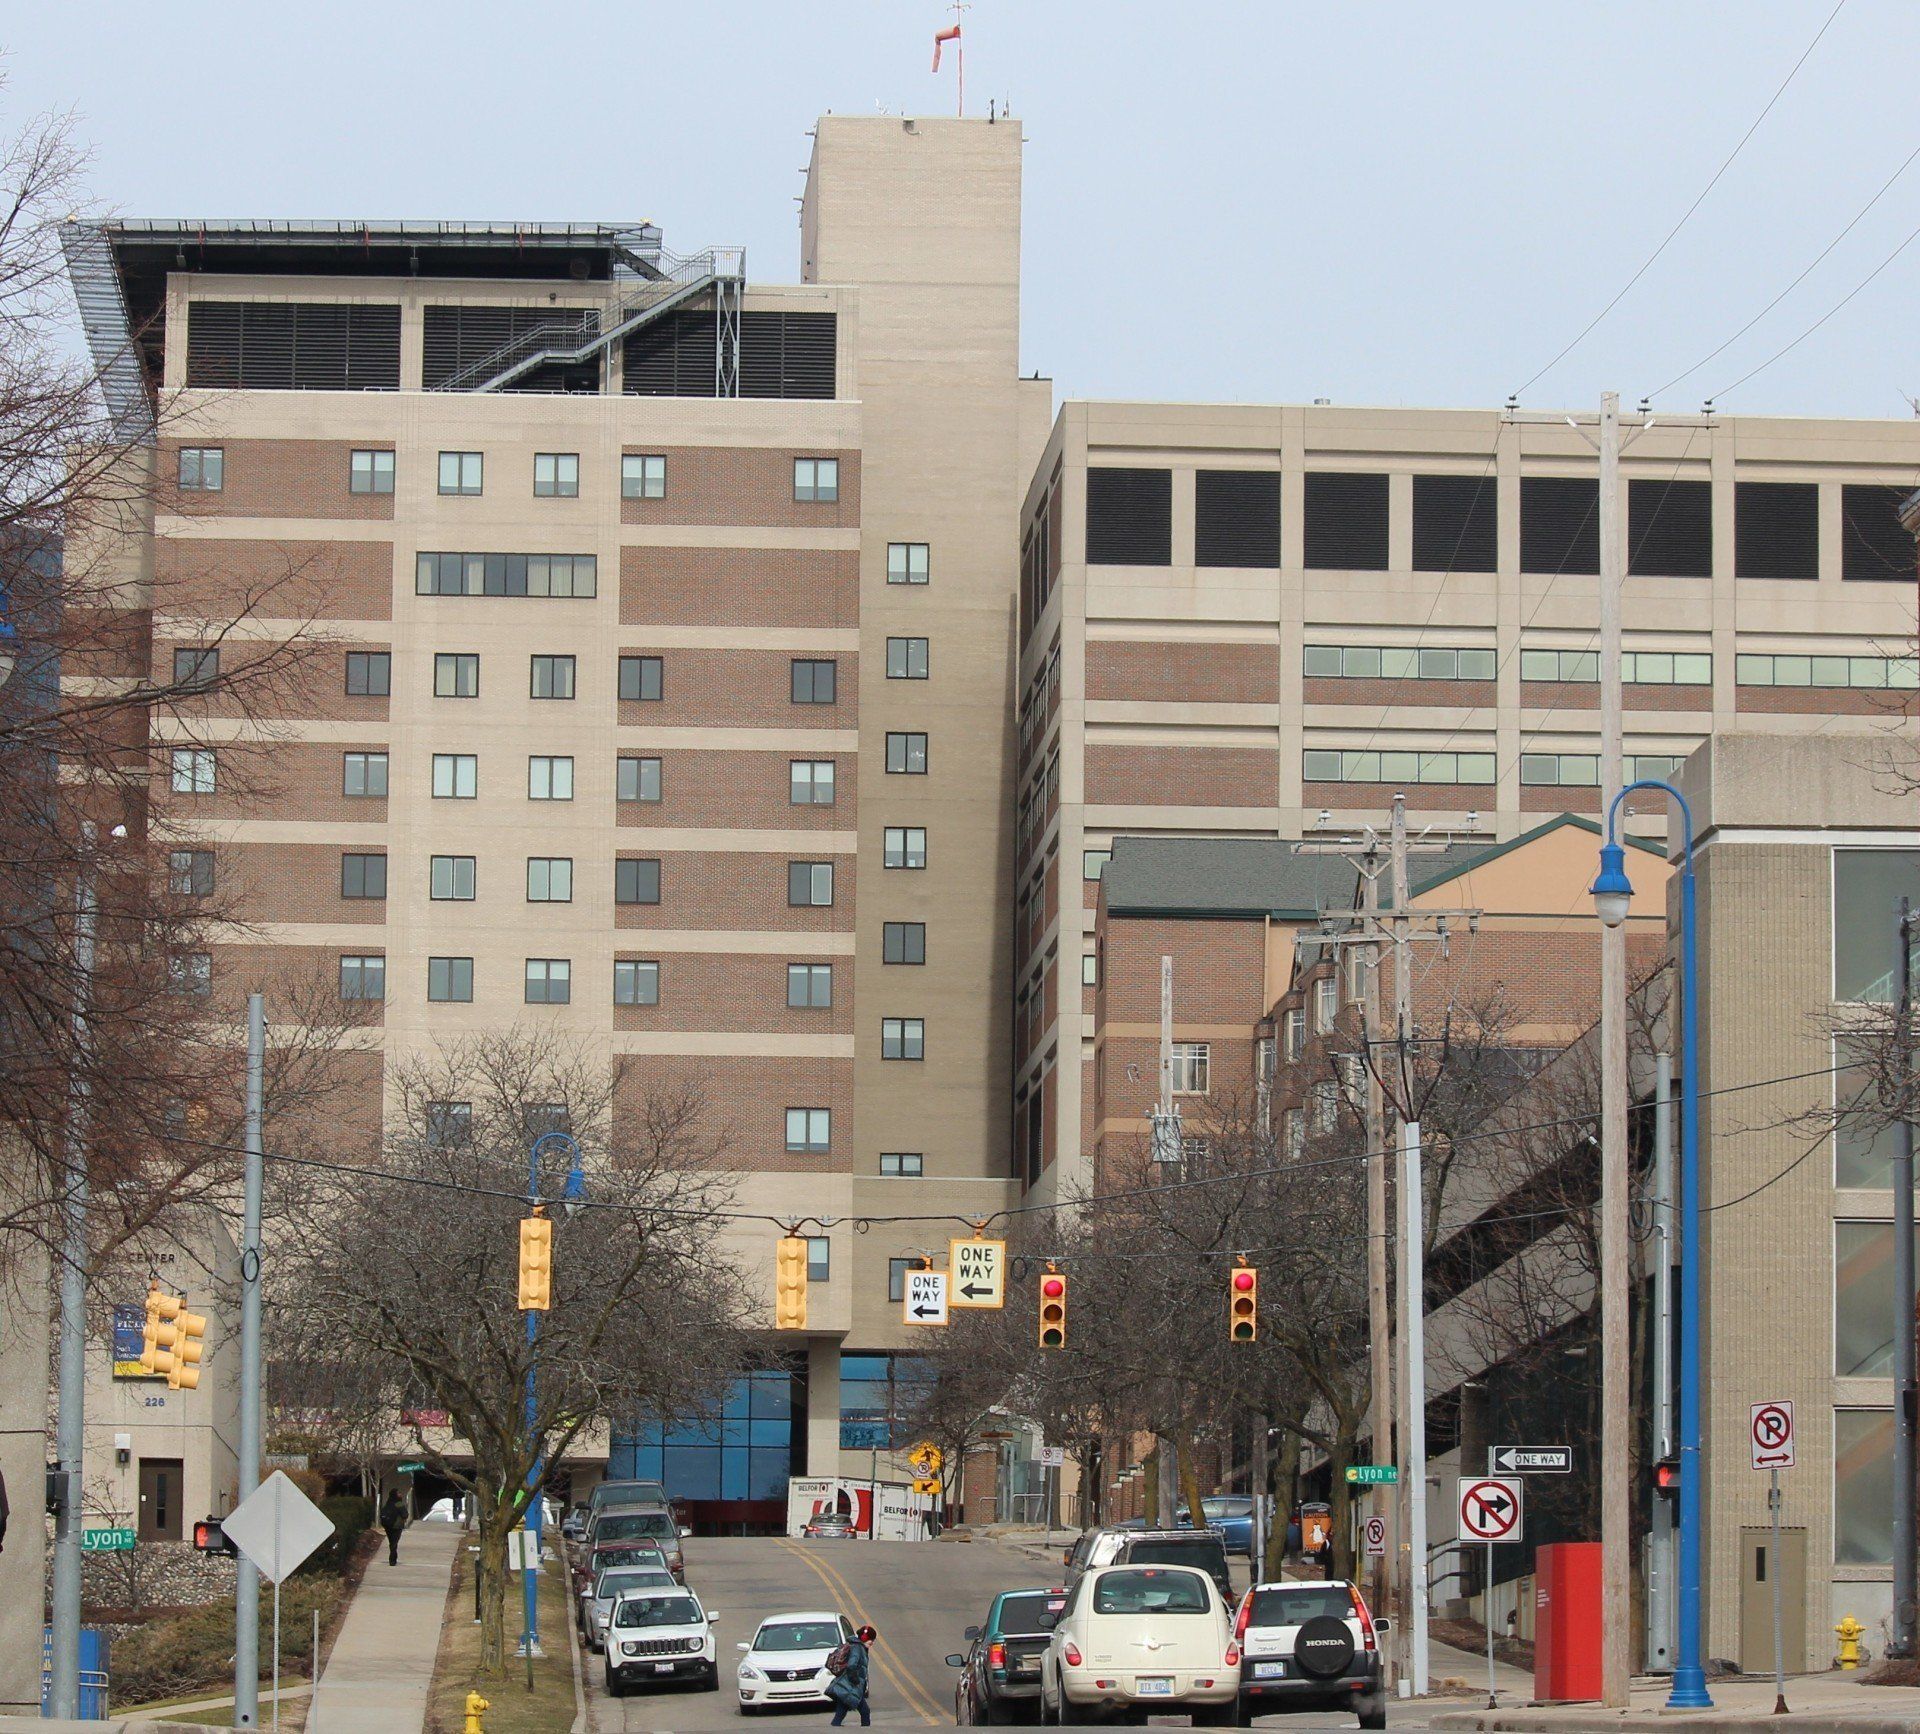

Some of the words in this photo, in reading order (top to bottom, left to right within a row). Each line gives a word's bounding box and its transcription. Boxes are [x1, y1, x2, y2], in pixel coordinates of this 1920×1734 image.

[129, 1253, 175, 1263] CENTER
[961, 1248, 993, 1262] ONE
[960, 1265, 994, 1279] WAY
[913, 1277, 940, 1288] ONE
[912, 1291, 940, 1302] WAY
[1515, 1454, 1537, 1464] ONE
[1541, 1454, 1562, 1464] WAY
[1359, 1467, 1383, 1481] Lyon
[798, 1484, 818, 1492] BELFOR
[884, 1505, 908, 1515] BELFOR
[84, 1530, 122, 1549] Lyon
